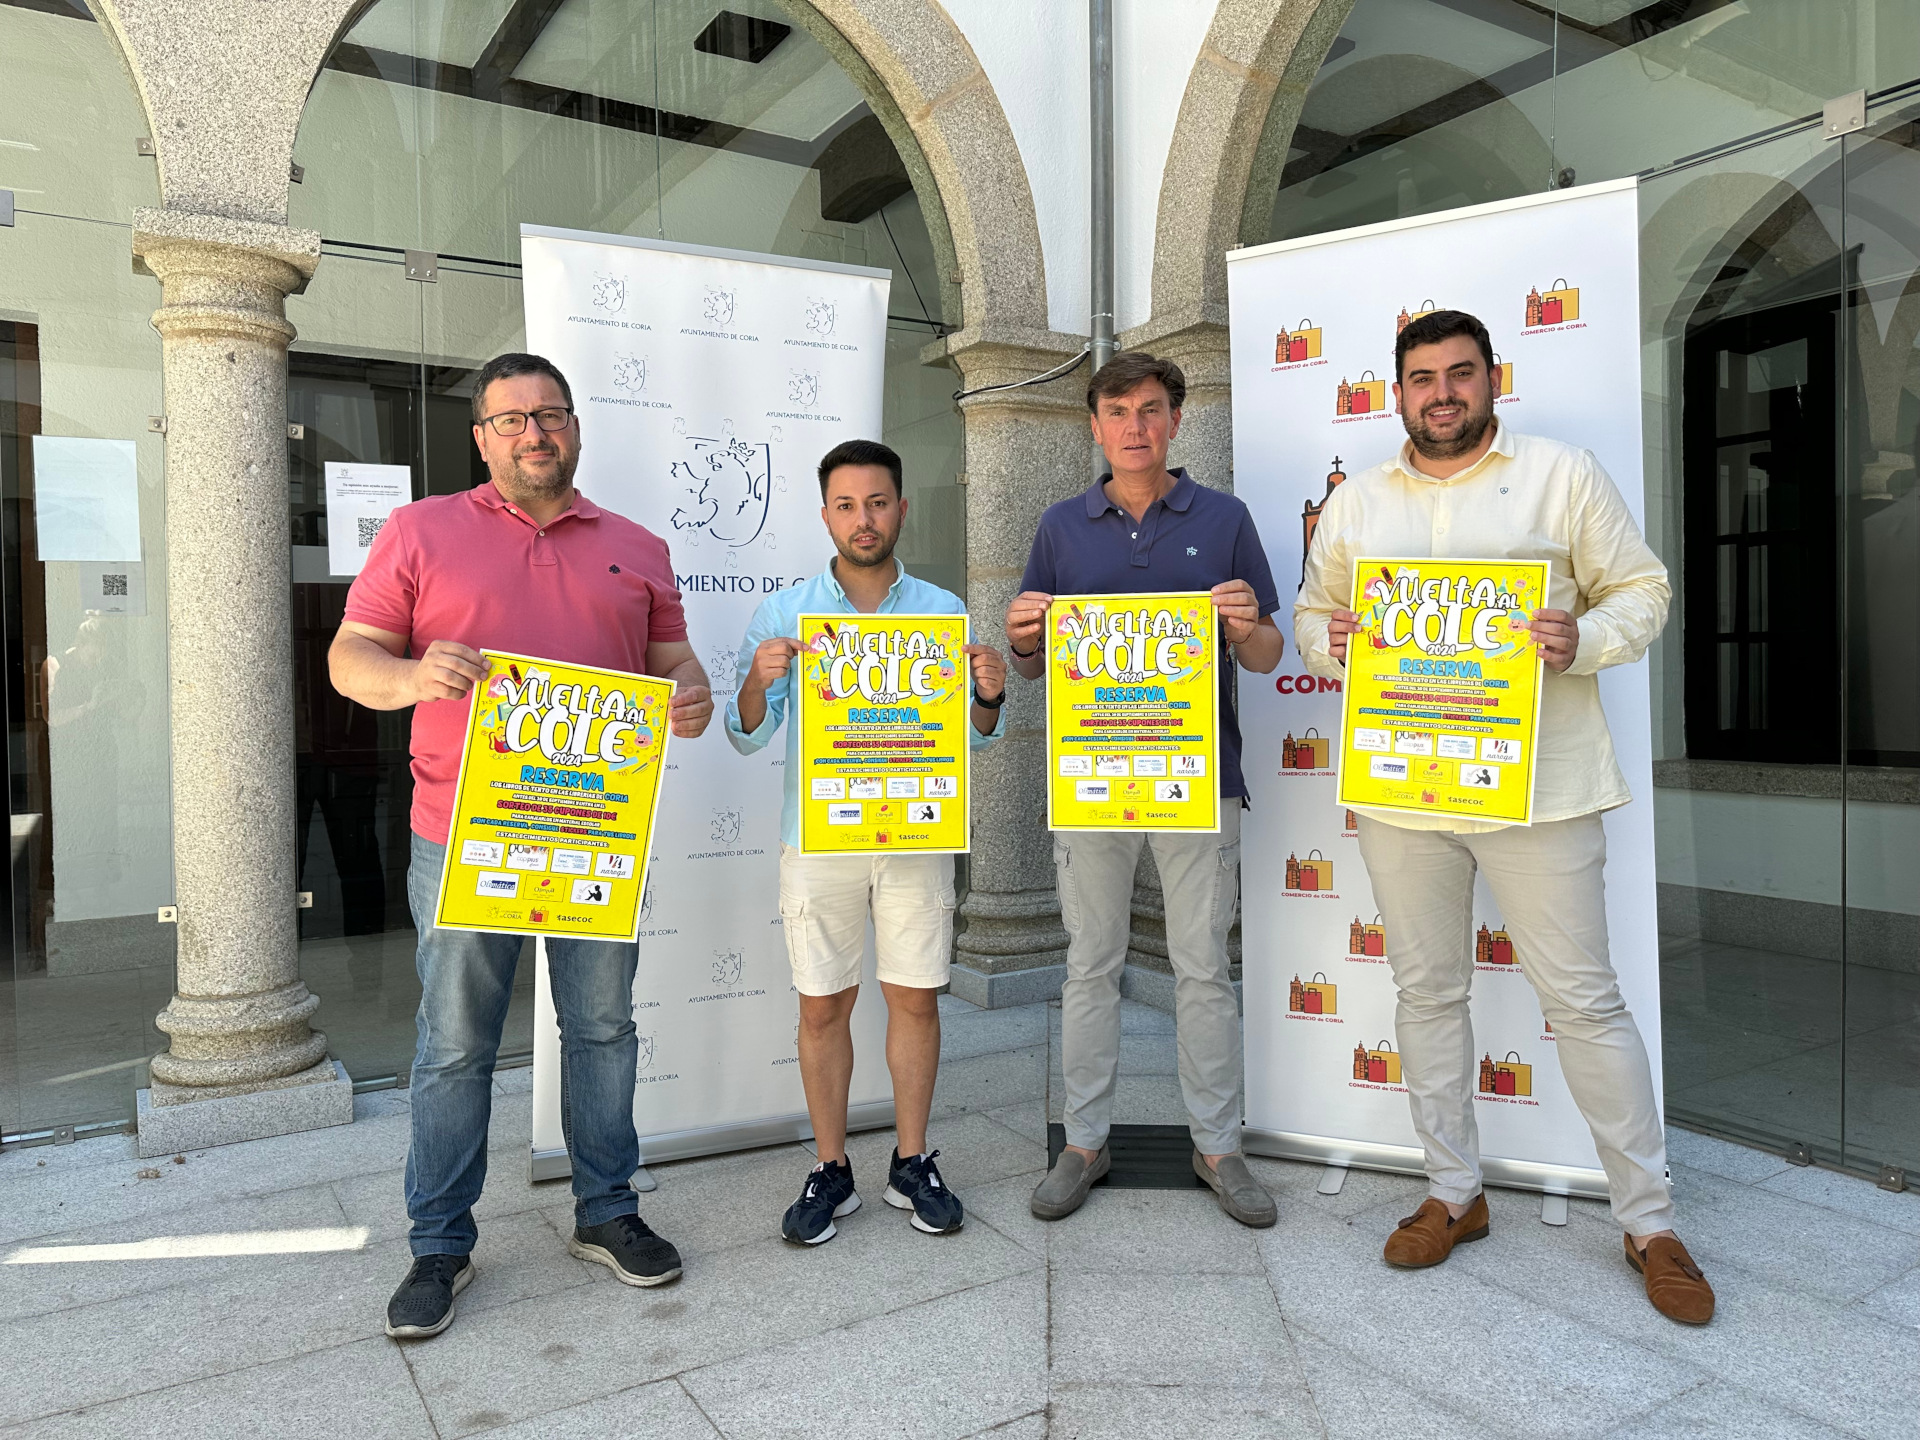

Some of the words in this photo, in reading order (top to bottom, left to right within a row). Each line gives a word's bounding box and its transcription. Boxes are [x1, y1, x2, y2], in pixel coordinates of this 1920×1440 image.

[568, 316, 620, 327] AYUNTAMIENTO
[631, 323, 651, 331] CORIA
[680, 328, 729, 339] AYUNTAMIENTO
[1520, 327, 1555, 336] COMERCIO
[784, 339, 830, 349] AYUNTAMIENTO
[1271, 363, 1300, 372] COMERCIO
[590, 396, 640, 406] AYUNTAMIENTO
[766, 412, 812, 420] AYUNTAMIENTO
[1332, 416, 1363, 424] COMERCIO
[676, 575, 755, 592] MIENTO
[763, 577, 784, 593] DE
[1497, 593, 1520, 609] AL
[1173, 623, 1195, 637] AL
[1382, 602, 1507, 652] COLE
[927, 644, 948, 658] AL
[1426, 644, 1456, 656] 2024
[1076, 634, 1185, 680] COLE
[1399, 658, 1482, 678] RESERVA
[830, 654, 938, 700] COLE
[1117, 672, 1144, 684] 2024
[1483, 679, 1509, 688] CORIA
[871, 693, 898, 704] 2024
[1094, 686, 1167, 703] RESERVA
[1381, 691, 1412, 700] SORTEO
[1424, 693, 1434, 702] 35
[1435, 695, 1472, 705] CUPONES
[1473, 697, 1483, 705] DE
[624, 708, 648, 724] AL
[848, 707, 920, 724] RESERVA
[1080, 719, 1108, 727] SORTEO
[1382, 720, 1441, 729] ESTABLECIMIENTOS
[1442, 724, 1493, 733] PARTICIPANTES:
[505, 704, 635, 763] COLE
[881, 740, 913, 748] CUPONES
[551, 752, 582, 767] 2024
[1486, 752, 1514, 762] naroga
[520, 765, 604, 791] RESERVA
[1176, 768, 1200, 776] naroga
[604, 792, 628, 803] CORIA
[929, 789, 951, 797] naroga
[497, 800, 530, 811] SORTEO
[531, 804, 542, 812] DE
[543, 805, 553, 814] 35
[554, 806, 592, 818] CUPONES
[592, 811, 602, 819] DE
[496, 831, 559, 844] ESTABLECIMIENTOS
[559, 838, 609, 848] PARTICIPANTES:
[687, 851, 735, 859] AYUNTAMIENTO
[601, 869, 626, 877] naroga
[688, 990, 736, 1003] AYUNTAMIENTO
[1474, 1095, 1508, 1103] COMERCIO
